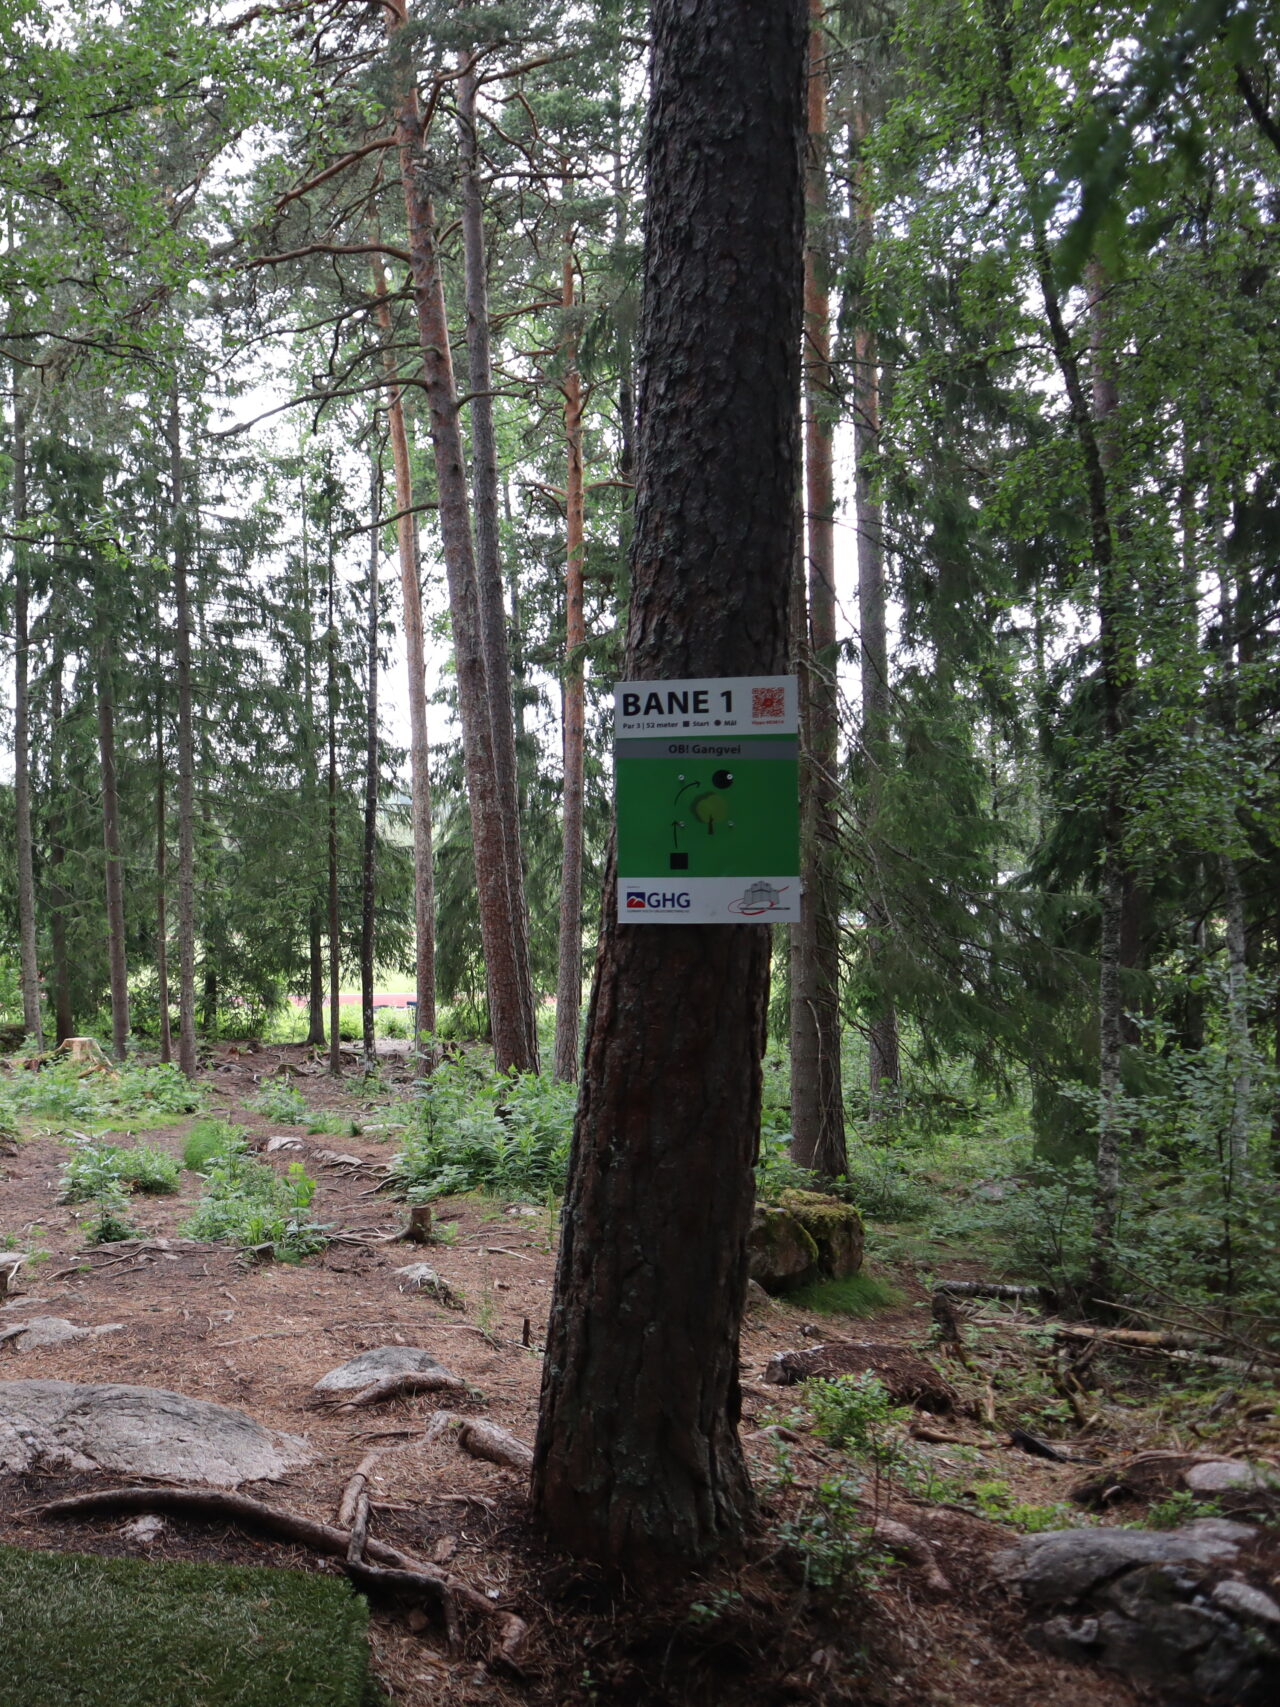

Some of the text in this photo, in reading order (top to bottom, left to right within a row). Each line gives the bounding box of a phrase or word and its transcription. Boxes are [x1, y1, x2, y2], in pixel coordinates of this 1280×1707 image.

[622, 690, 733, 717] BANE 1
[668, 743, 741, 757] OB! Gangvei
[647, 892, 691, 908] GHG
